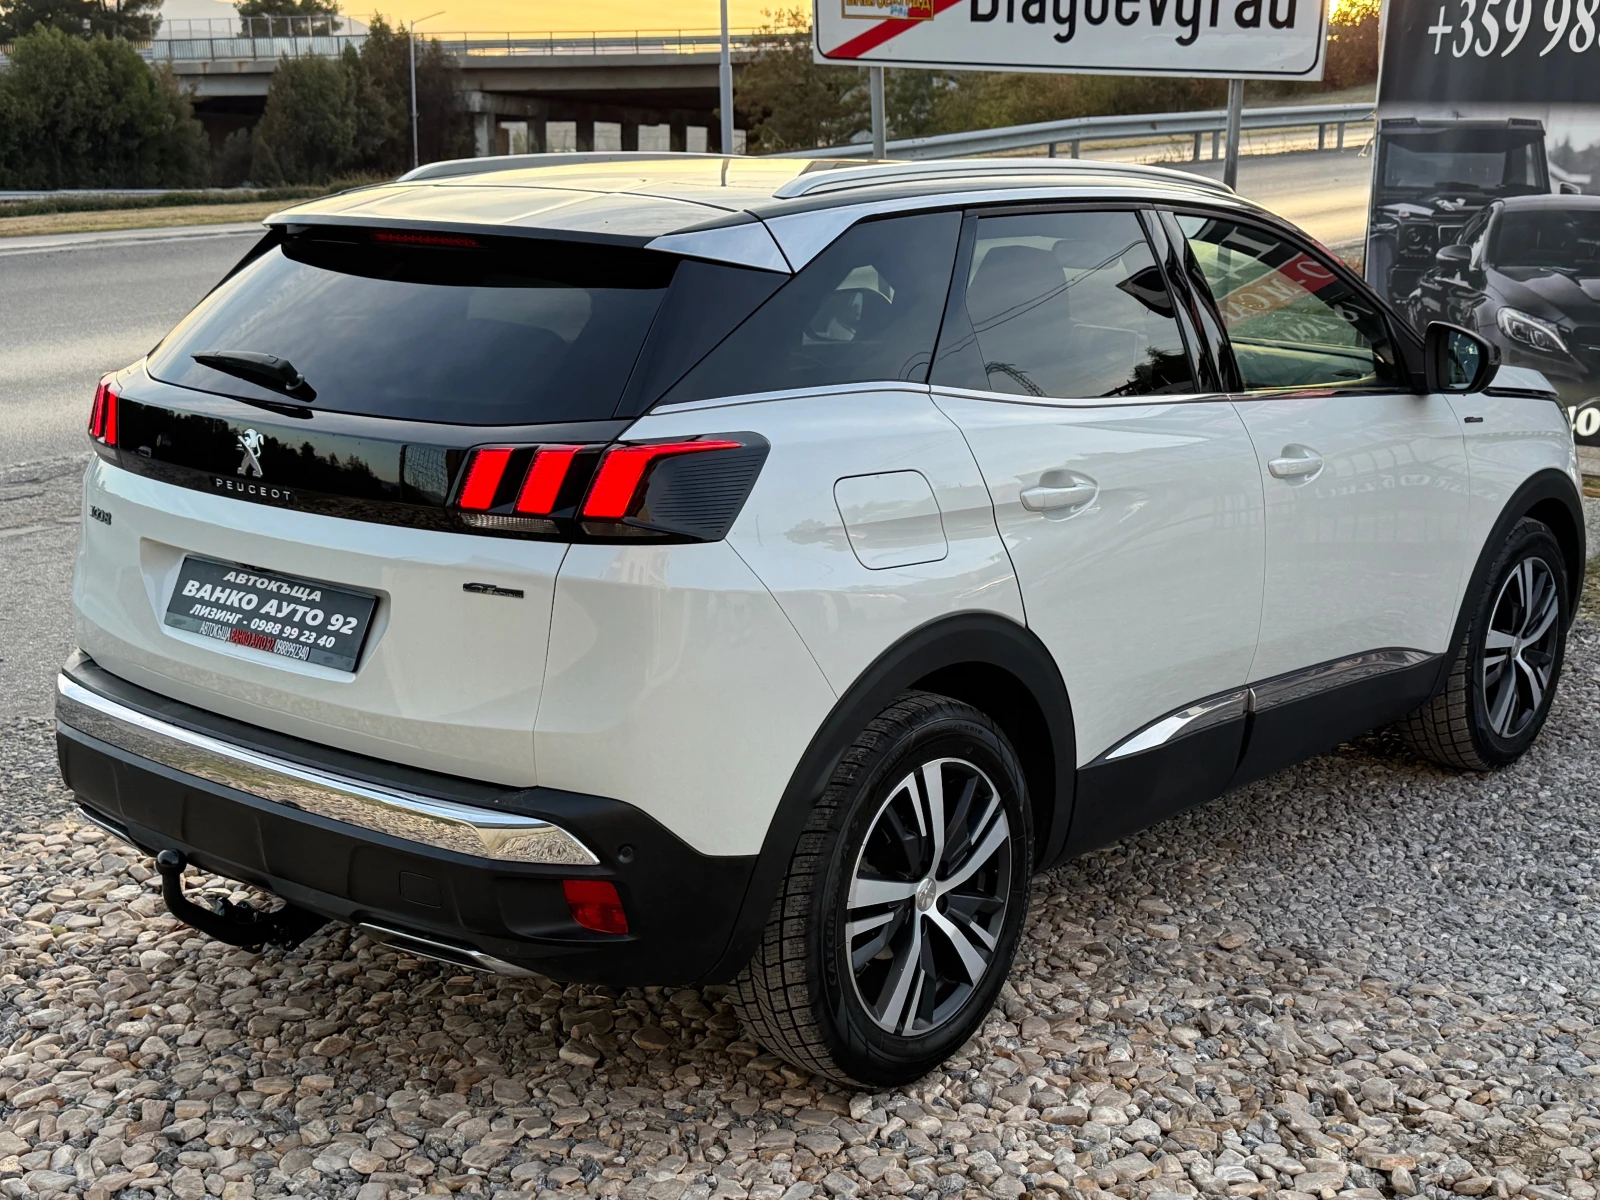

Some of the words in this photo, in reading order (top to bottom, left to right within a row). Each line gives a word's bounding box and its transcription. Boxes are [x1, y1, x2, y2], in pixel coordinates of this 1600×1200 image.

[1427, 0, 1533, 58] +359
[1539, 0, 1600, 57] 98
[215, 478, 291, 501] PEUGEOT
[182, 580, 259, 610] ВАНКО
[259, 599, 325, 626] АУТО
[327, 613, 358, 635] 92
[223, 571, 322, 602] АВТОКЪЩА
[190, 603, 243, 626] ЛИЗИНГ
[250, 618, 281, 636] 0988
[282, 625, 299, 640] 99
[300, 630, 316, 644] 23
[317, 634, 336, 648] 40
[199, 621, 232, 643] АВТОКЪЩА
[231, 629, 251, 646] ВАНКО
[250, 633, 267, 650] АУТО
[266, 637, 276, 652] 92
[273, 639, 310, 661] 0988992340
